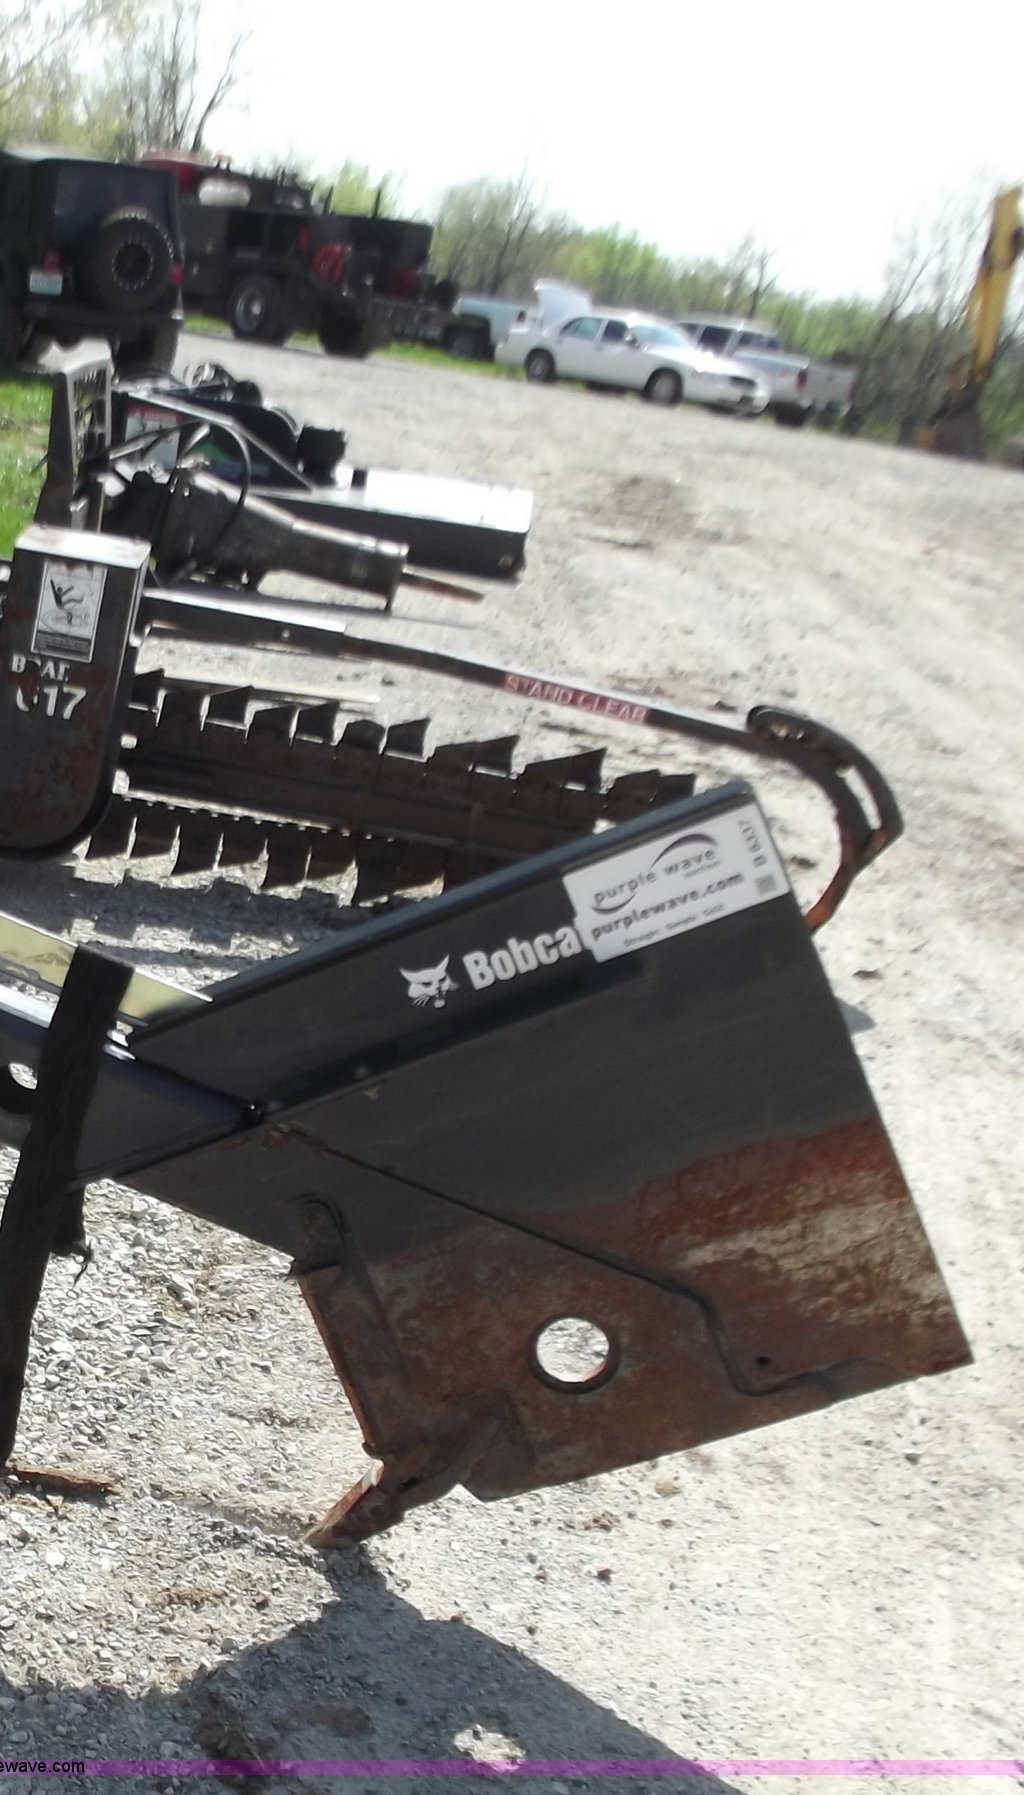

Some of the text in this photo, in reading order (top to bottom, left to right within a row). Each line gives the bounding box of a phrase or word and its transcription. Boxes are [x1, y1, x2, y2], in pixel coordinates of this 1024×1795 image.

[505, 674, 650, 723] STAND CLEAR
[591, 873, 745, 941] purplewave.com
[593, 870, 657, 906] purple
[663, 849, 717, 875] wave
[462, 919, 591, 990] Bobca
